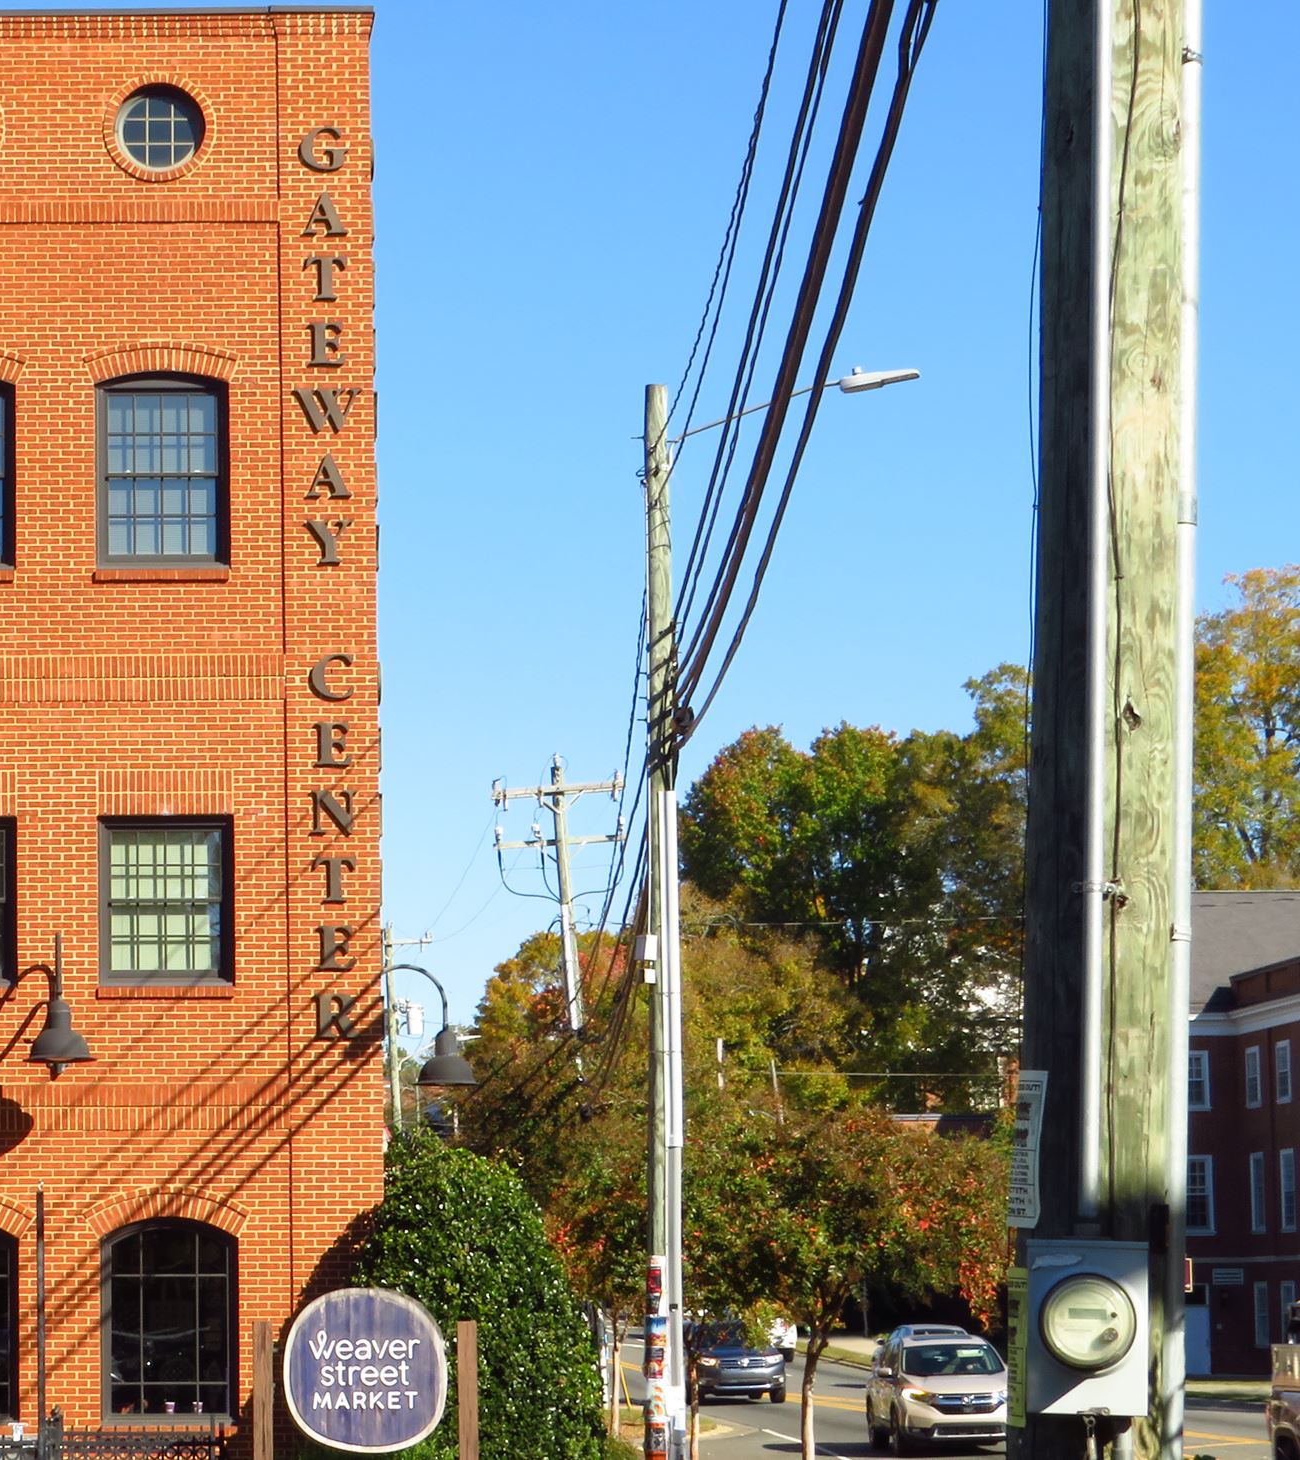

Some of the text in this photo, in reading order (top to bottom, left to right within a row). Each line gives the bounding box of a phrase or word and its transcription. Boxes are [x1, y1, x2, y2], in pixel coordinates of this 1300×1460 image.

[291, 127, 362, 567] GATEWAY
[308, 653, 357, 1042] CENTER
[312, 1390, 419, 1411] MARKET
[320, 1360, 410, 1387] street
